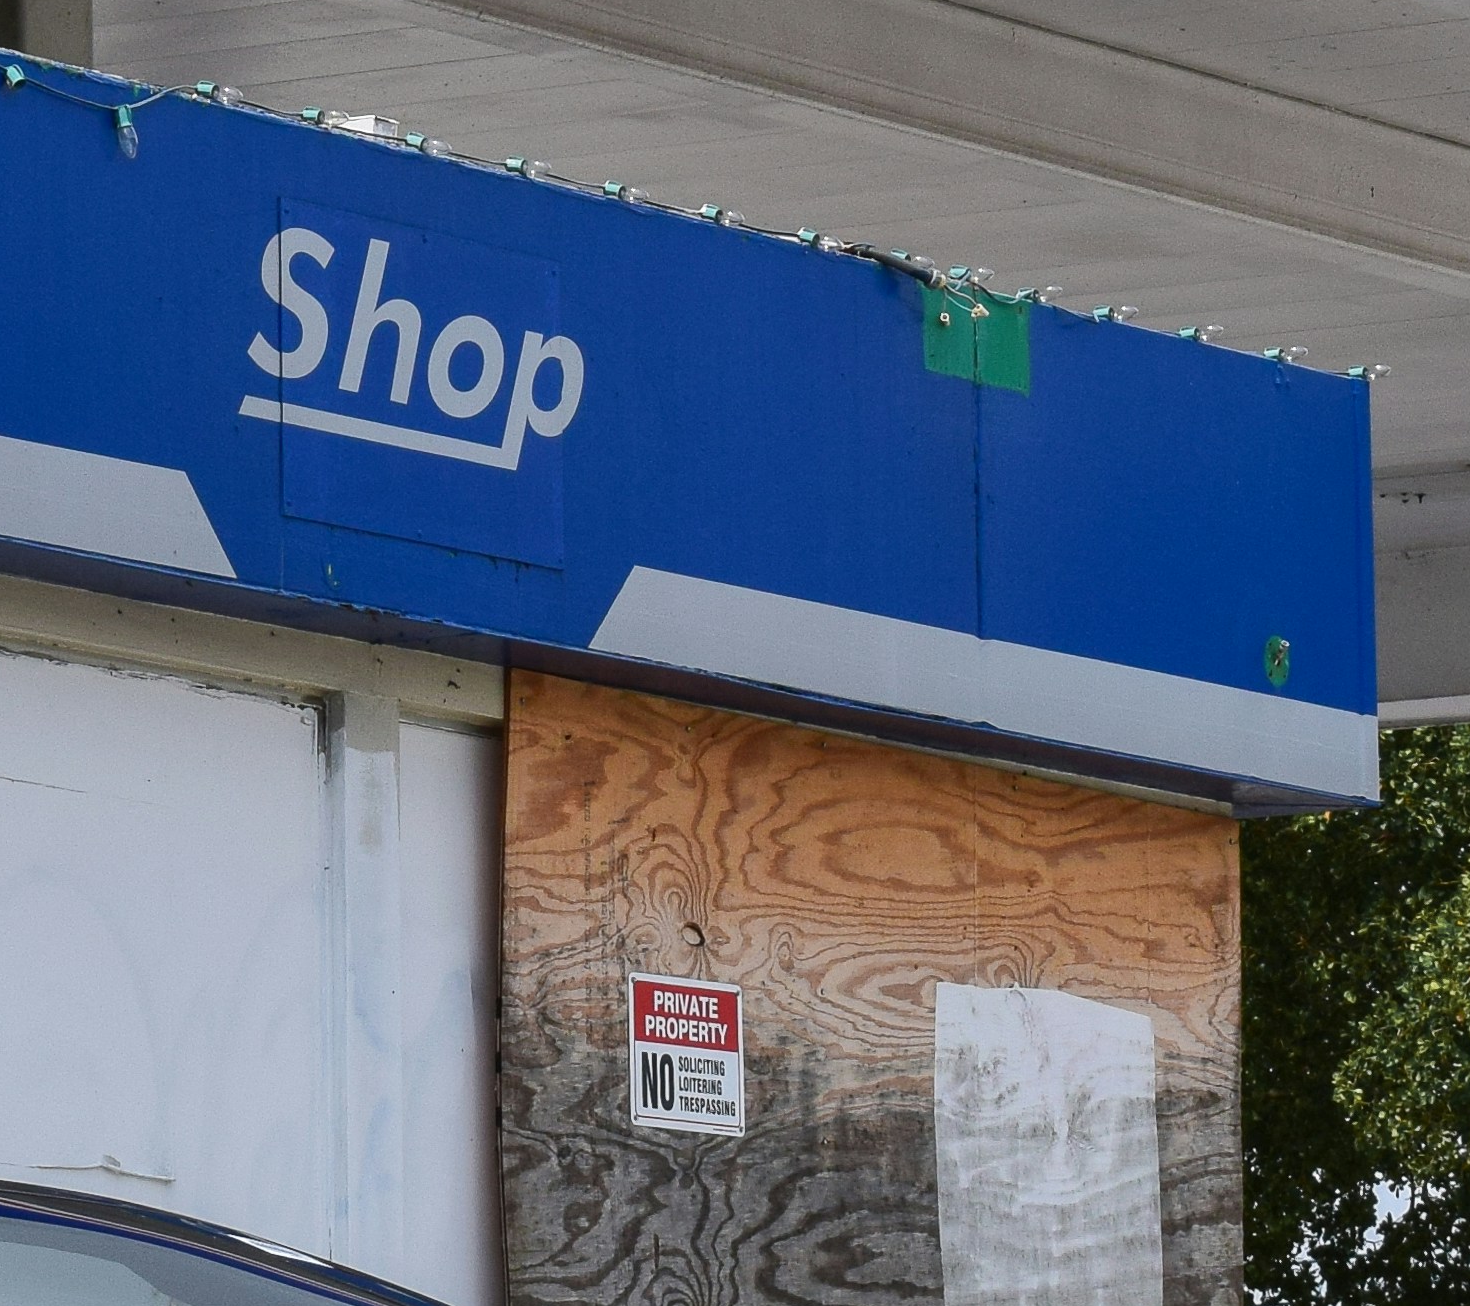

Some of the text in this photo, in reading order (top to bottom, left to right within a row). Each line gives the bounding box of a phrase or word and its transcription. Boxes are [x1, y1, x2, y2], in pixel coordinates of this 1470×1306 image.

[247, 227, 584, 471] Shop
[653, 990, 719, 1019] PRIVATE
[645, 1014, 728, 1045] PROPERTY
[678, 1055, 725, 1077] SOLICITING
[641, 1051, 675, 1111] NO
[678, 1076, 722, 1096] LOITERING
[678, 1096, 736, 1117] TRESPASSING
